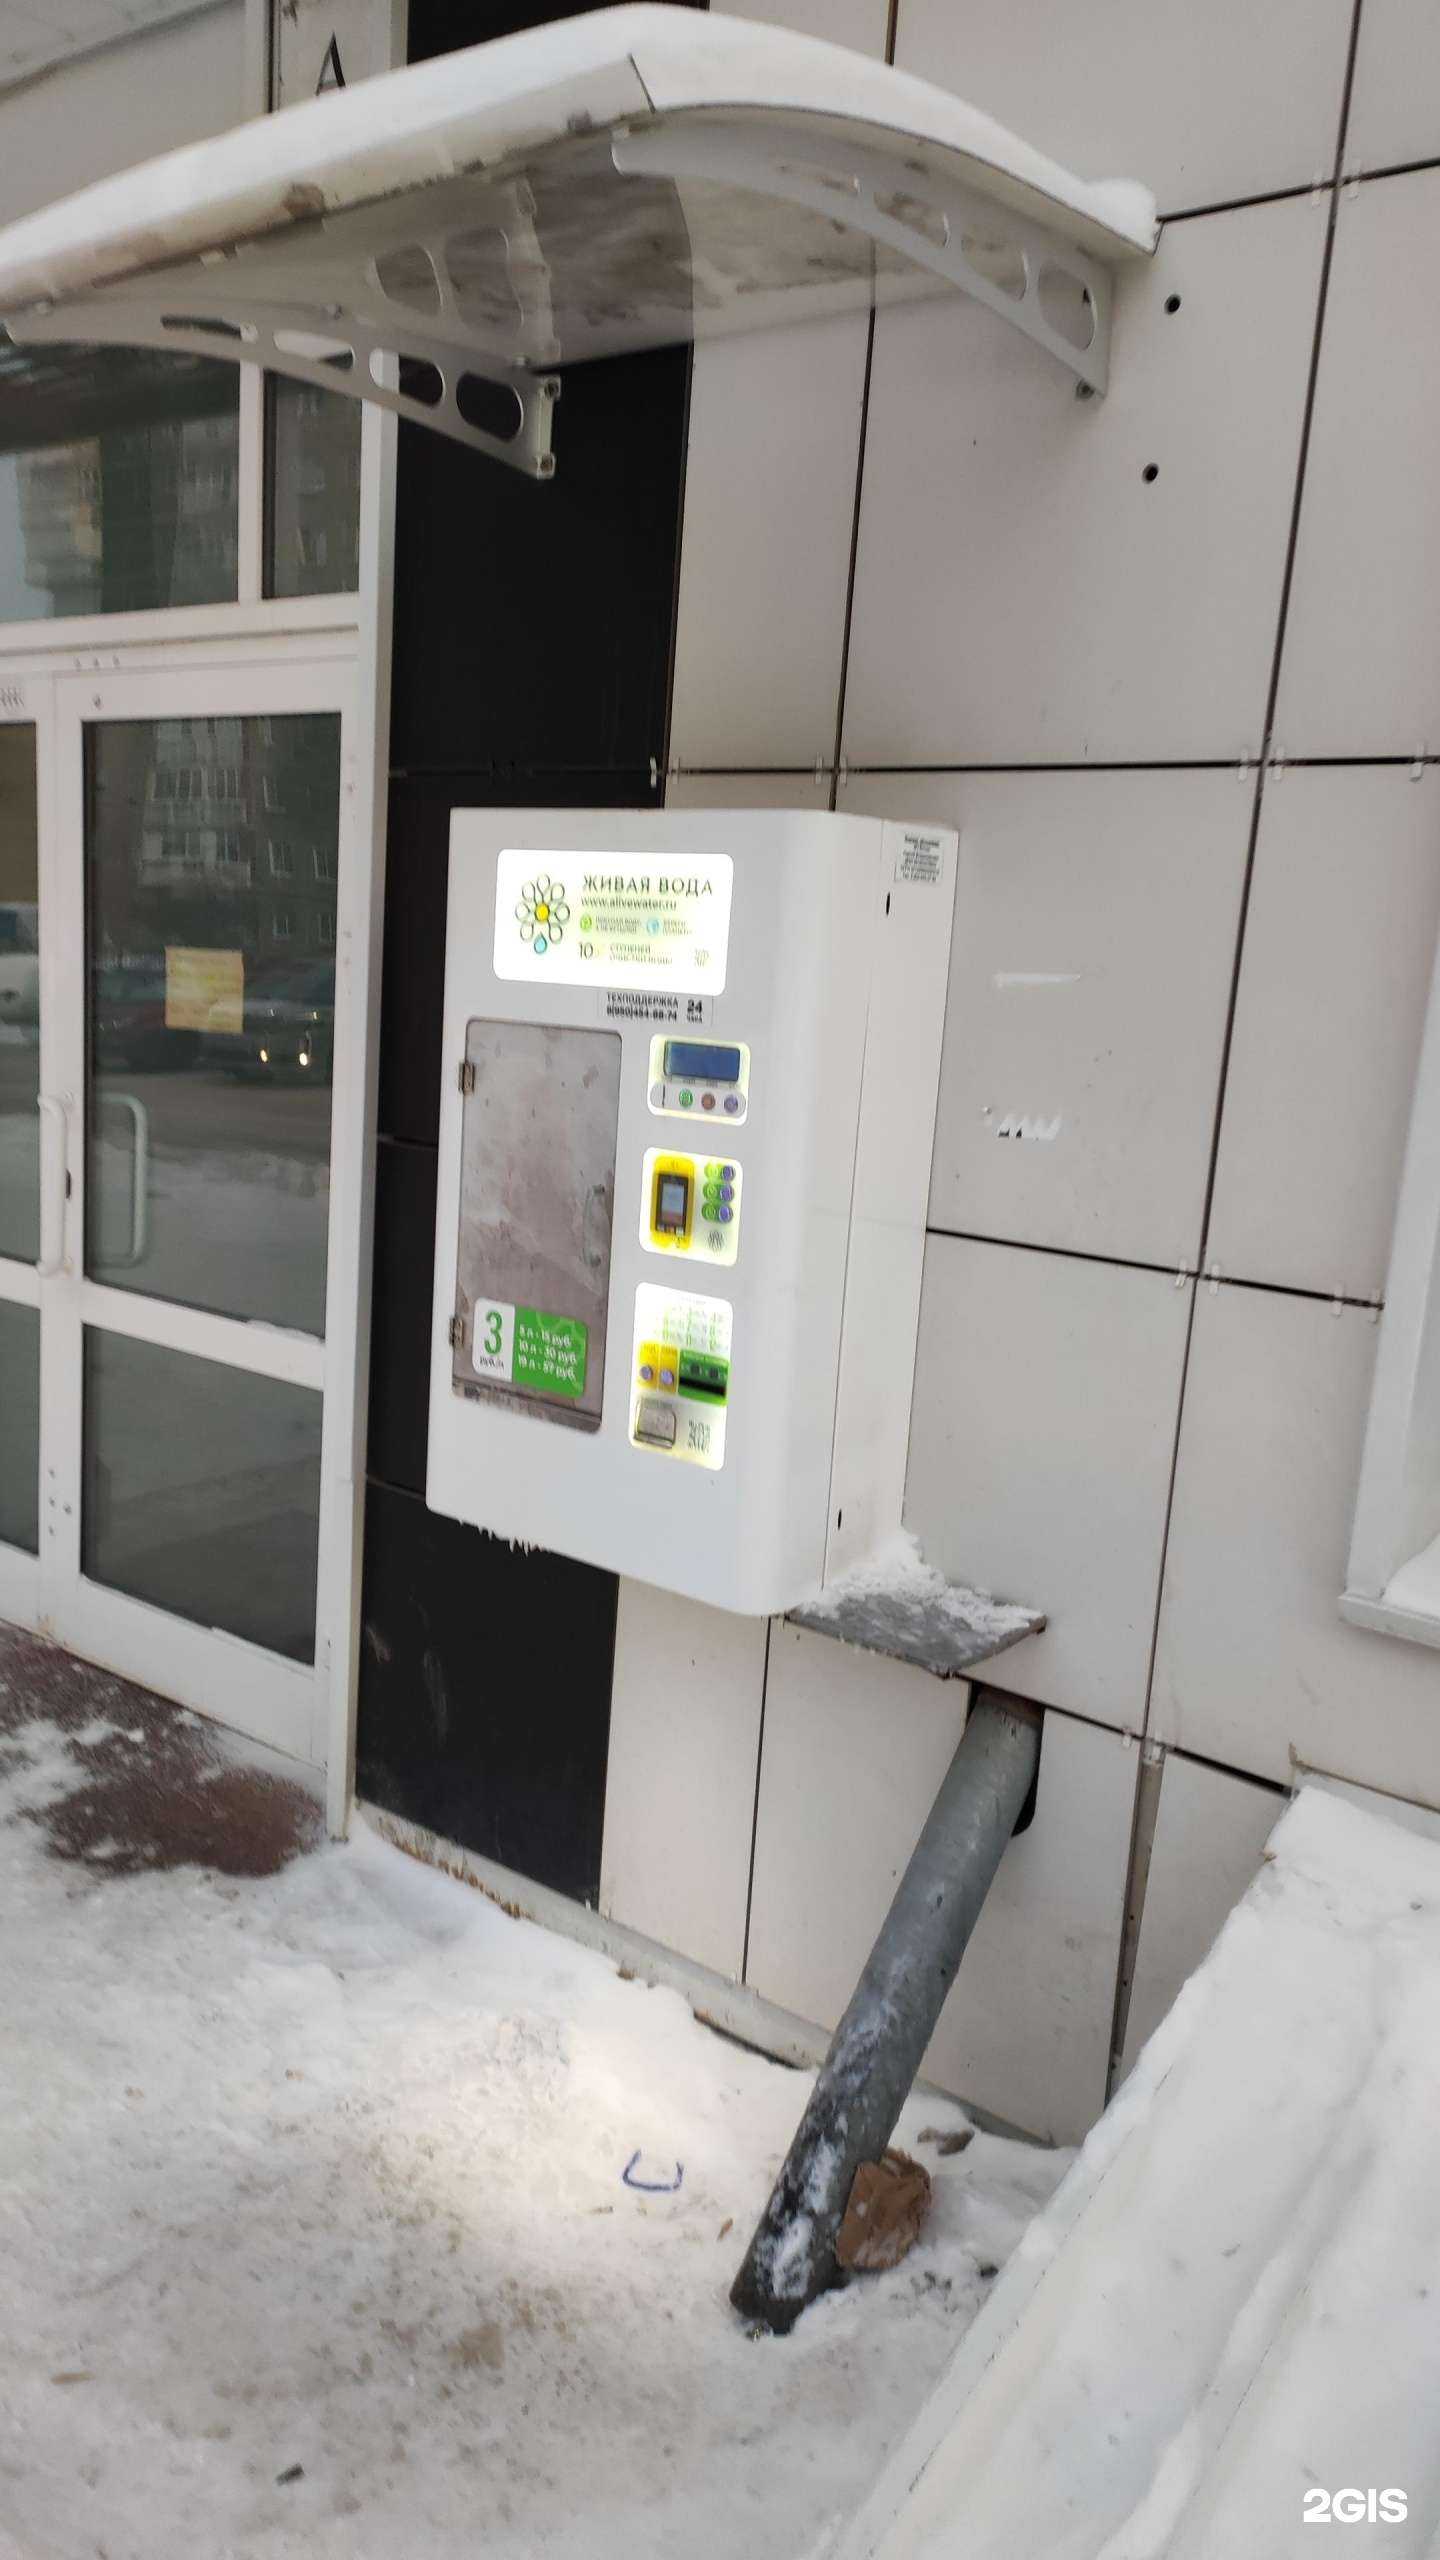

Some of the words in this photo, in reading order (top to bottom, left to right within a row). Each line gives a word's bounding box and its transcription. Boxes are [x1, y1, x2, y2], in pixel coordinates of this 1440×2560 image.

[582, 874, 651, 895] ЖИВАЯ
[658, 876, 713, 898] ВОДА
[580, 896, 678, 911] www.alivewater.ru
[578, 941, 594, 960] 10
[606, 991, 679, 1009] ТЕХПОДДЕРЖКА
[687, 999, 703, 1014] 24
[483, 1310, 503, 1355] 3
[519, 1339, 529, 1353] 10
